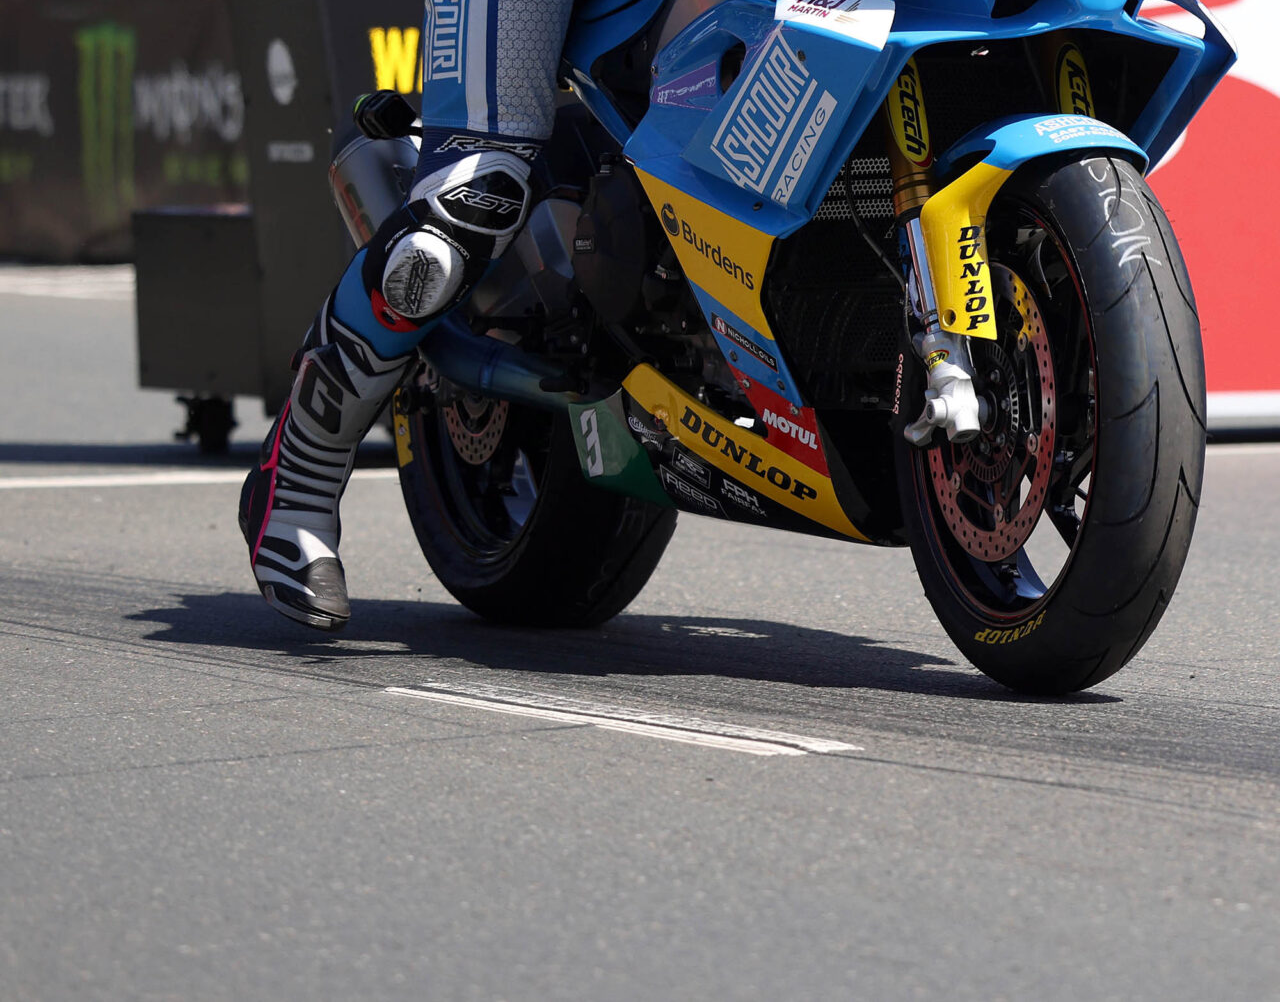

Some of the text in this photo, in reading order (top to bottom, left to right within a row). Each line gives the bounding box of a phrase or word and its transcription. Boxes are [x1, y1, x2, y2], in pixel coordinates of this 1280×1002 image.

[788, 5, 830, 18] MARTIN
[368, 26, 423, 94] W
[711, 24, 810, 194] ASHCOURT
[774, 107, 826, 201] RACING
[445, 186, 524, 214] RST
[682, 219, 755, 291] Burdens
[957, 225, 990, 331] DUNLOP
[728, 327, 757, 354] NICHOLL
[759, 350, 775, 367] OILS
[893, 353, 903, 414] brembo
[579, 407, 604, 478] 3
[680, 406, 818, 500] DUNLOP
[762, 408, 818, 451] MOTUL
[974, 609, 1046, 645] DUNLOP
